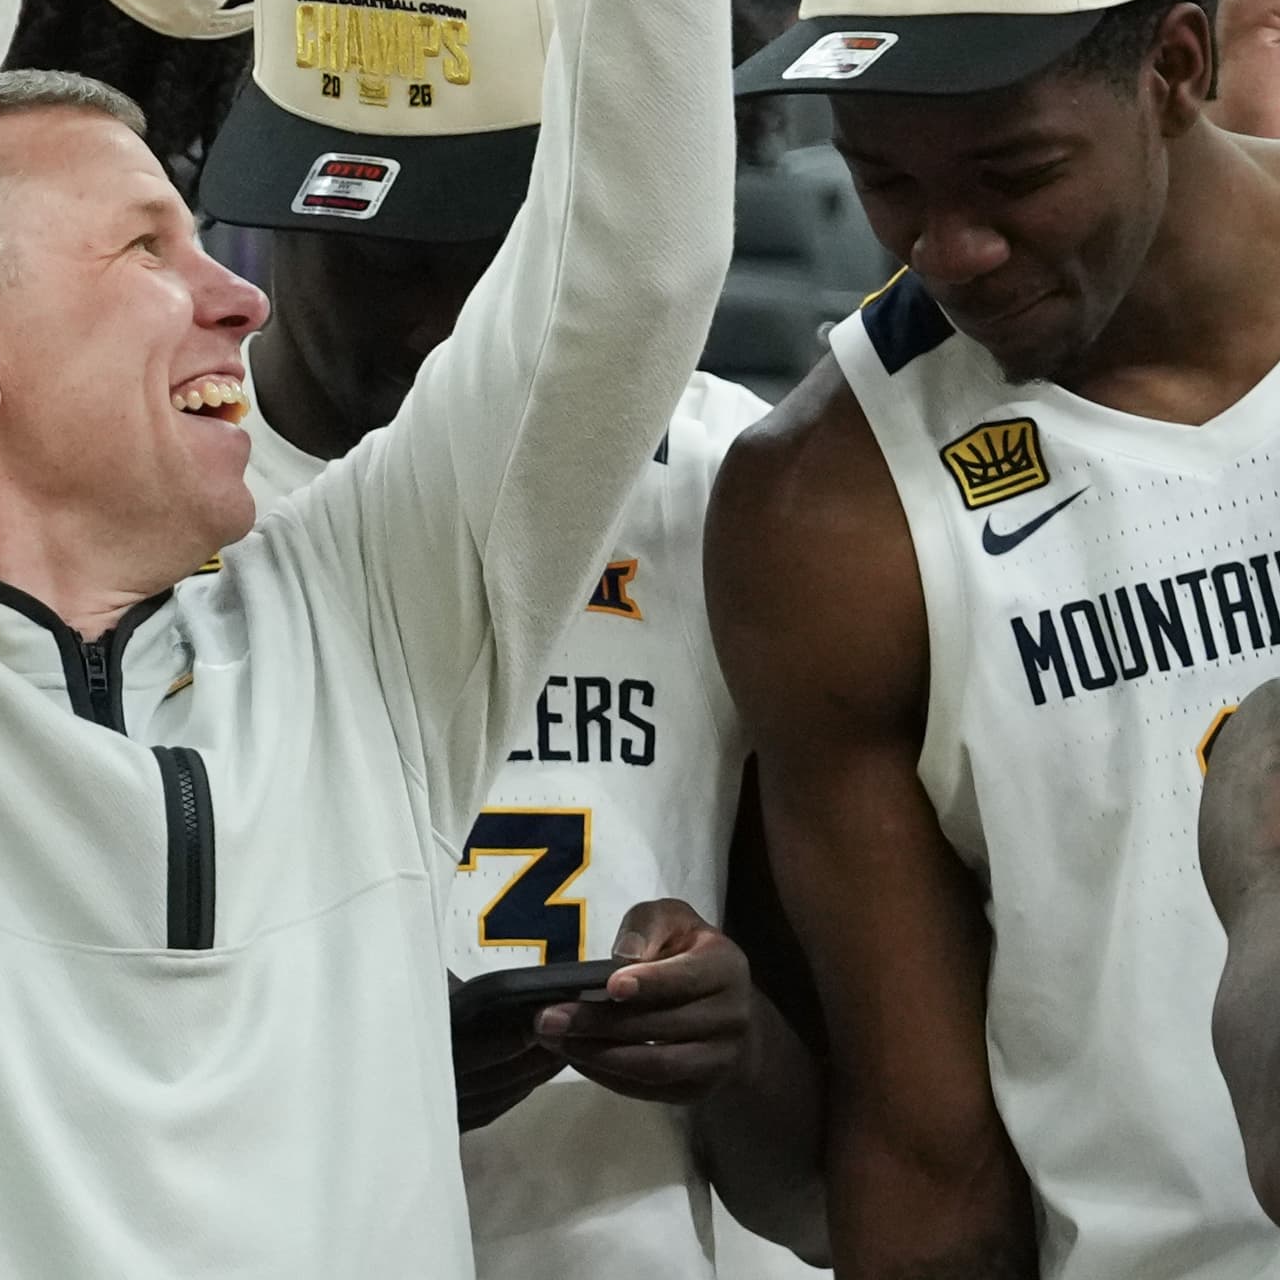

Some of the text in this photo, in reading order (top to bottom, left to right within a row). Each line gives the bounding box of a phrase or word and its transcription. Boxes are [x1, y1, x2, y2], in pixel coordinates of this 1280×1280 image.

[419, 2, 467, 20] CROWN
[296, 4, 471, 85] CHAMPS
[322, 73, 433, 107] 20 26
